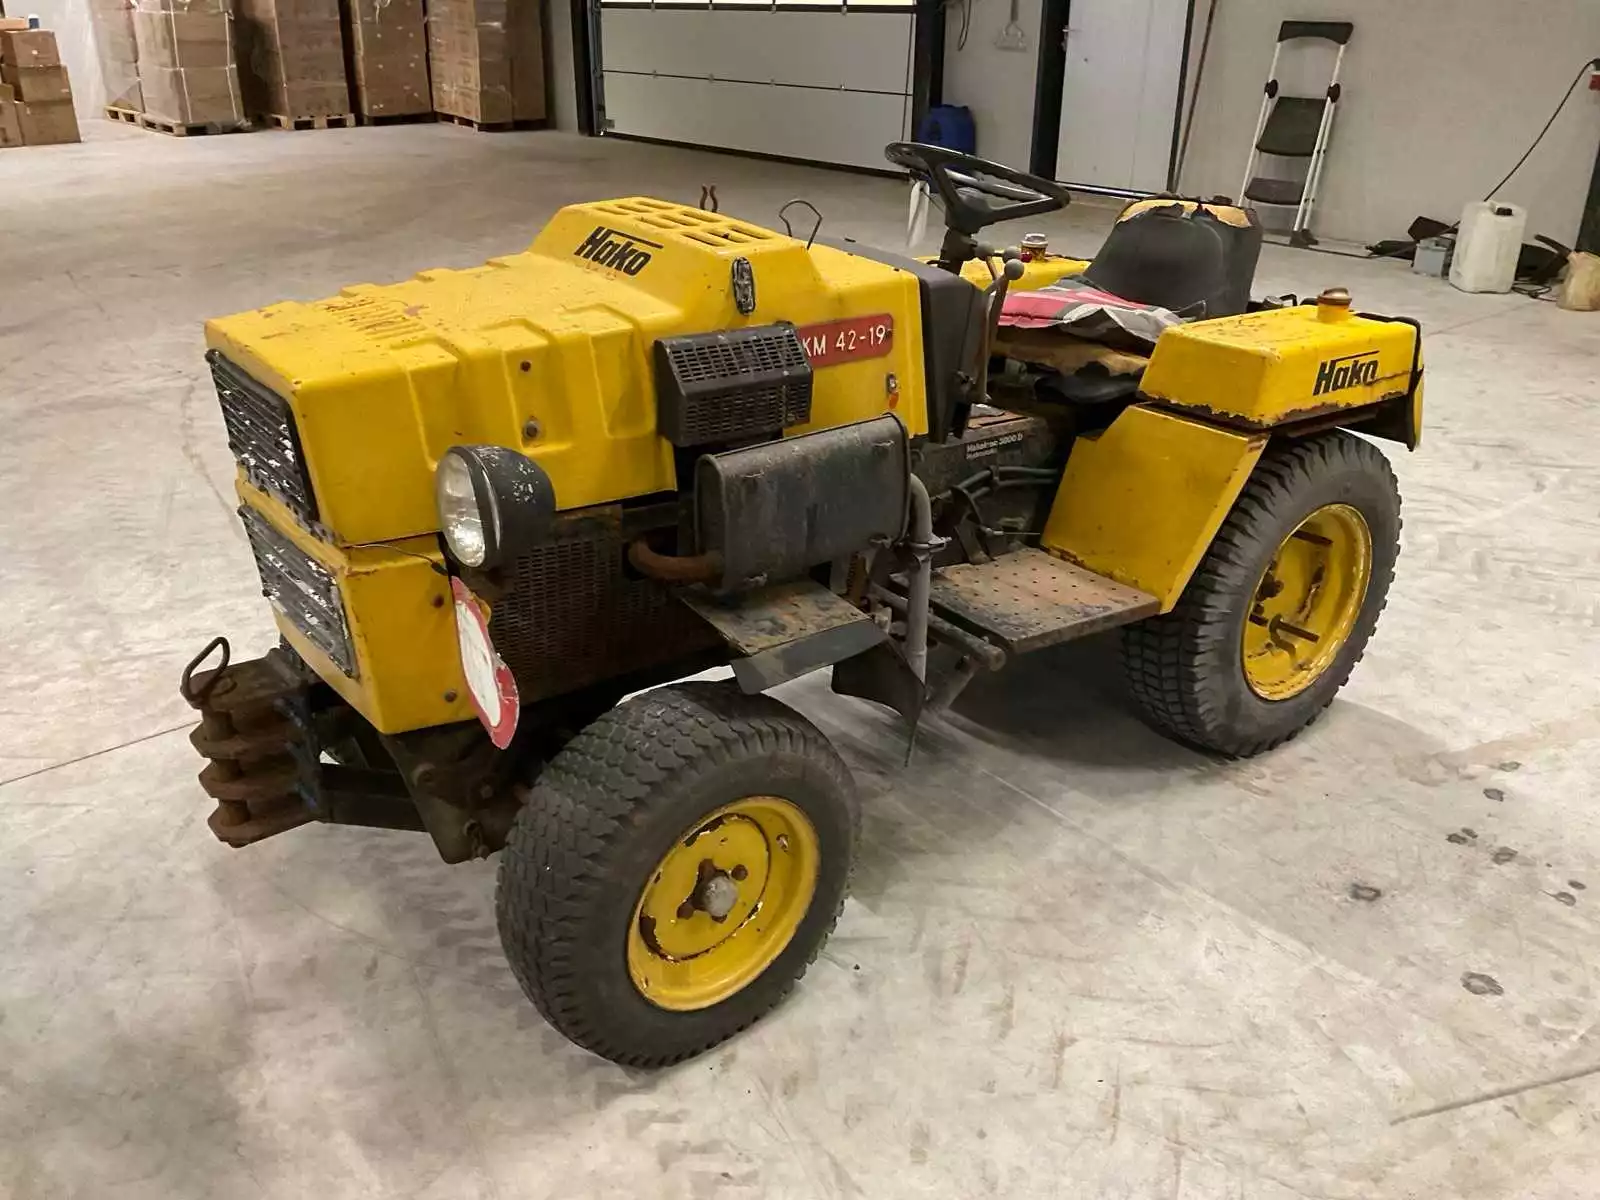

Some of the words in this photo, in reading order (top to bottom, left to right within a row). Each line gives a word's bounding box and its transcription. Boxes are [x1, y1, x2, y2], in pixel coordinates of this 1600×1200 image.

[573, 226, 664, 276] Hako
[802, 334, 826, 357] KM
[835, 325, 886, 351] 42-19
[1312, 350, 1380, 396] Hako
